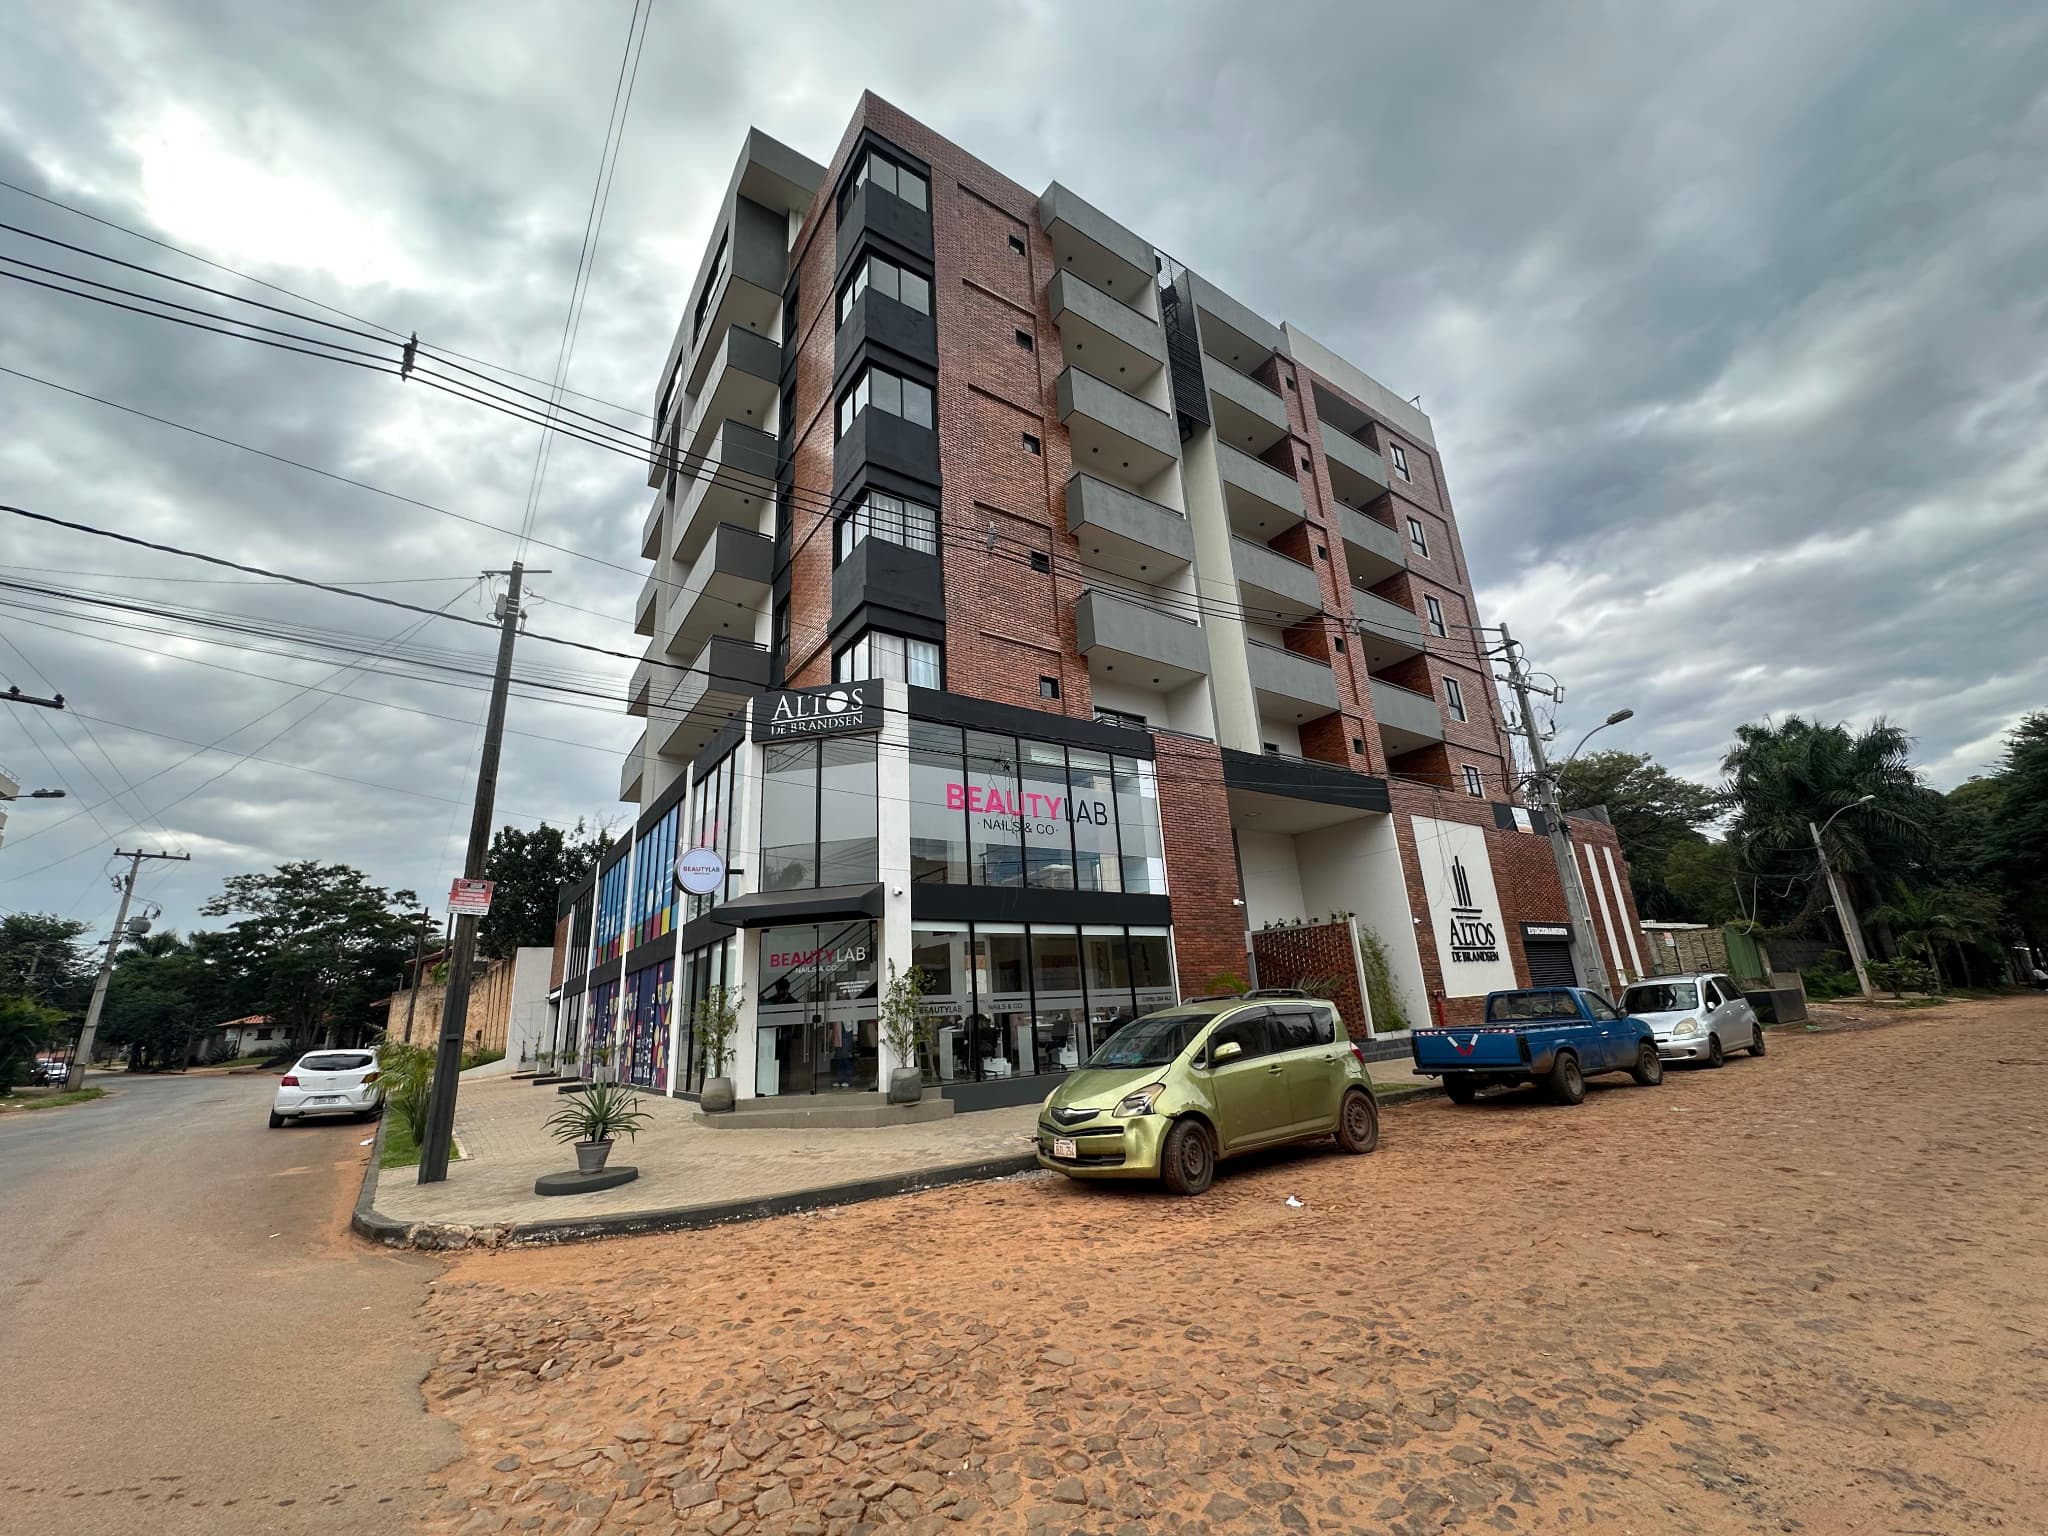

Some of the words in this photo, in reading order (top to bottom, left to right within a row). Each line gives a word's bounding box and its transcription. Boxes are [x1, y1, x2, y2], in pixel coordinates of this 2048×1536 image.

[772, 688, 863, 720] ALTOS
[771, 724, 787, 736] DE
[791, 715, 863, 733] BRANDSEN
[946, 783, 1108, 826] BEAUTYLAB
[983, 818, 1021, 834] NAILS
[1036, 823, 1055, 835] CO
[1450, 918, 1496, 946] ALTOS
[770, 946, 866, 968] BEAUTYLAB
[1451, 951, 1462, 963] DE
